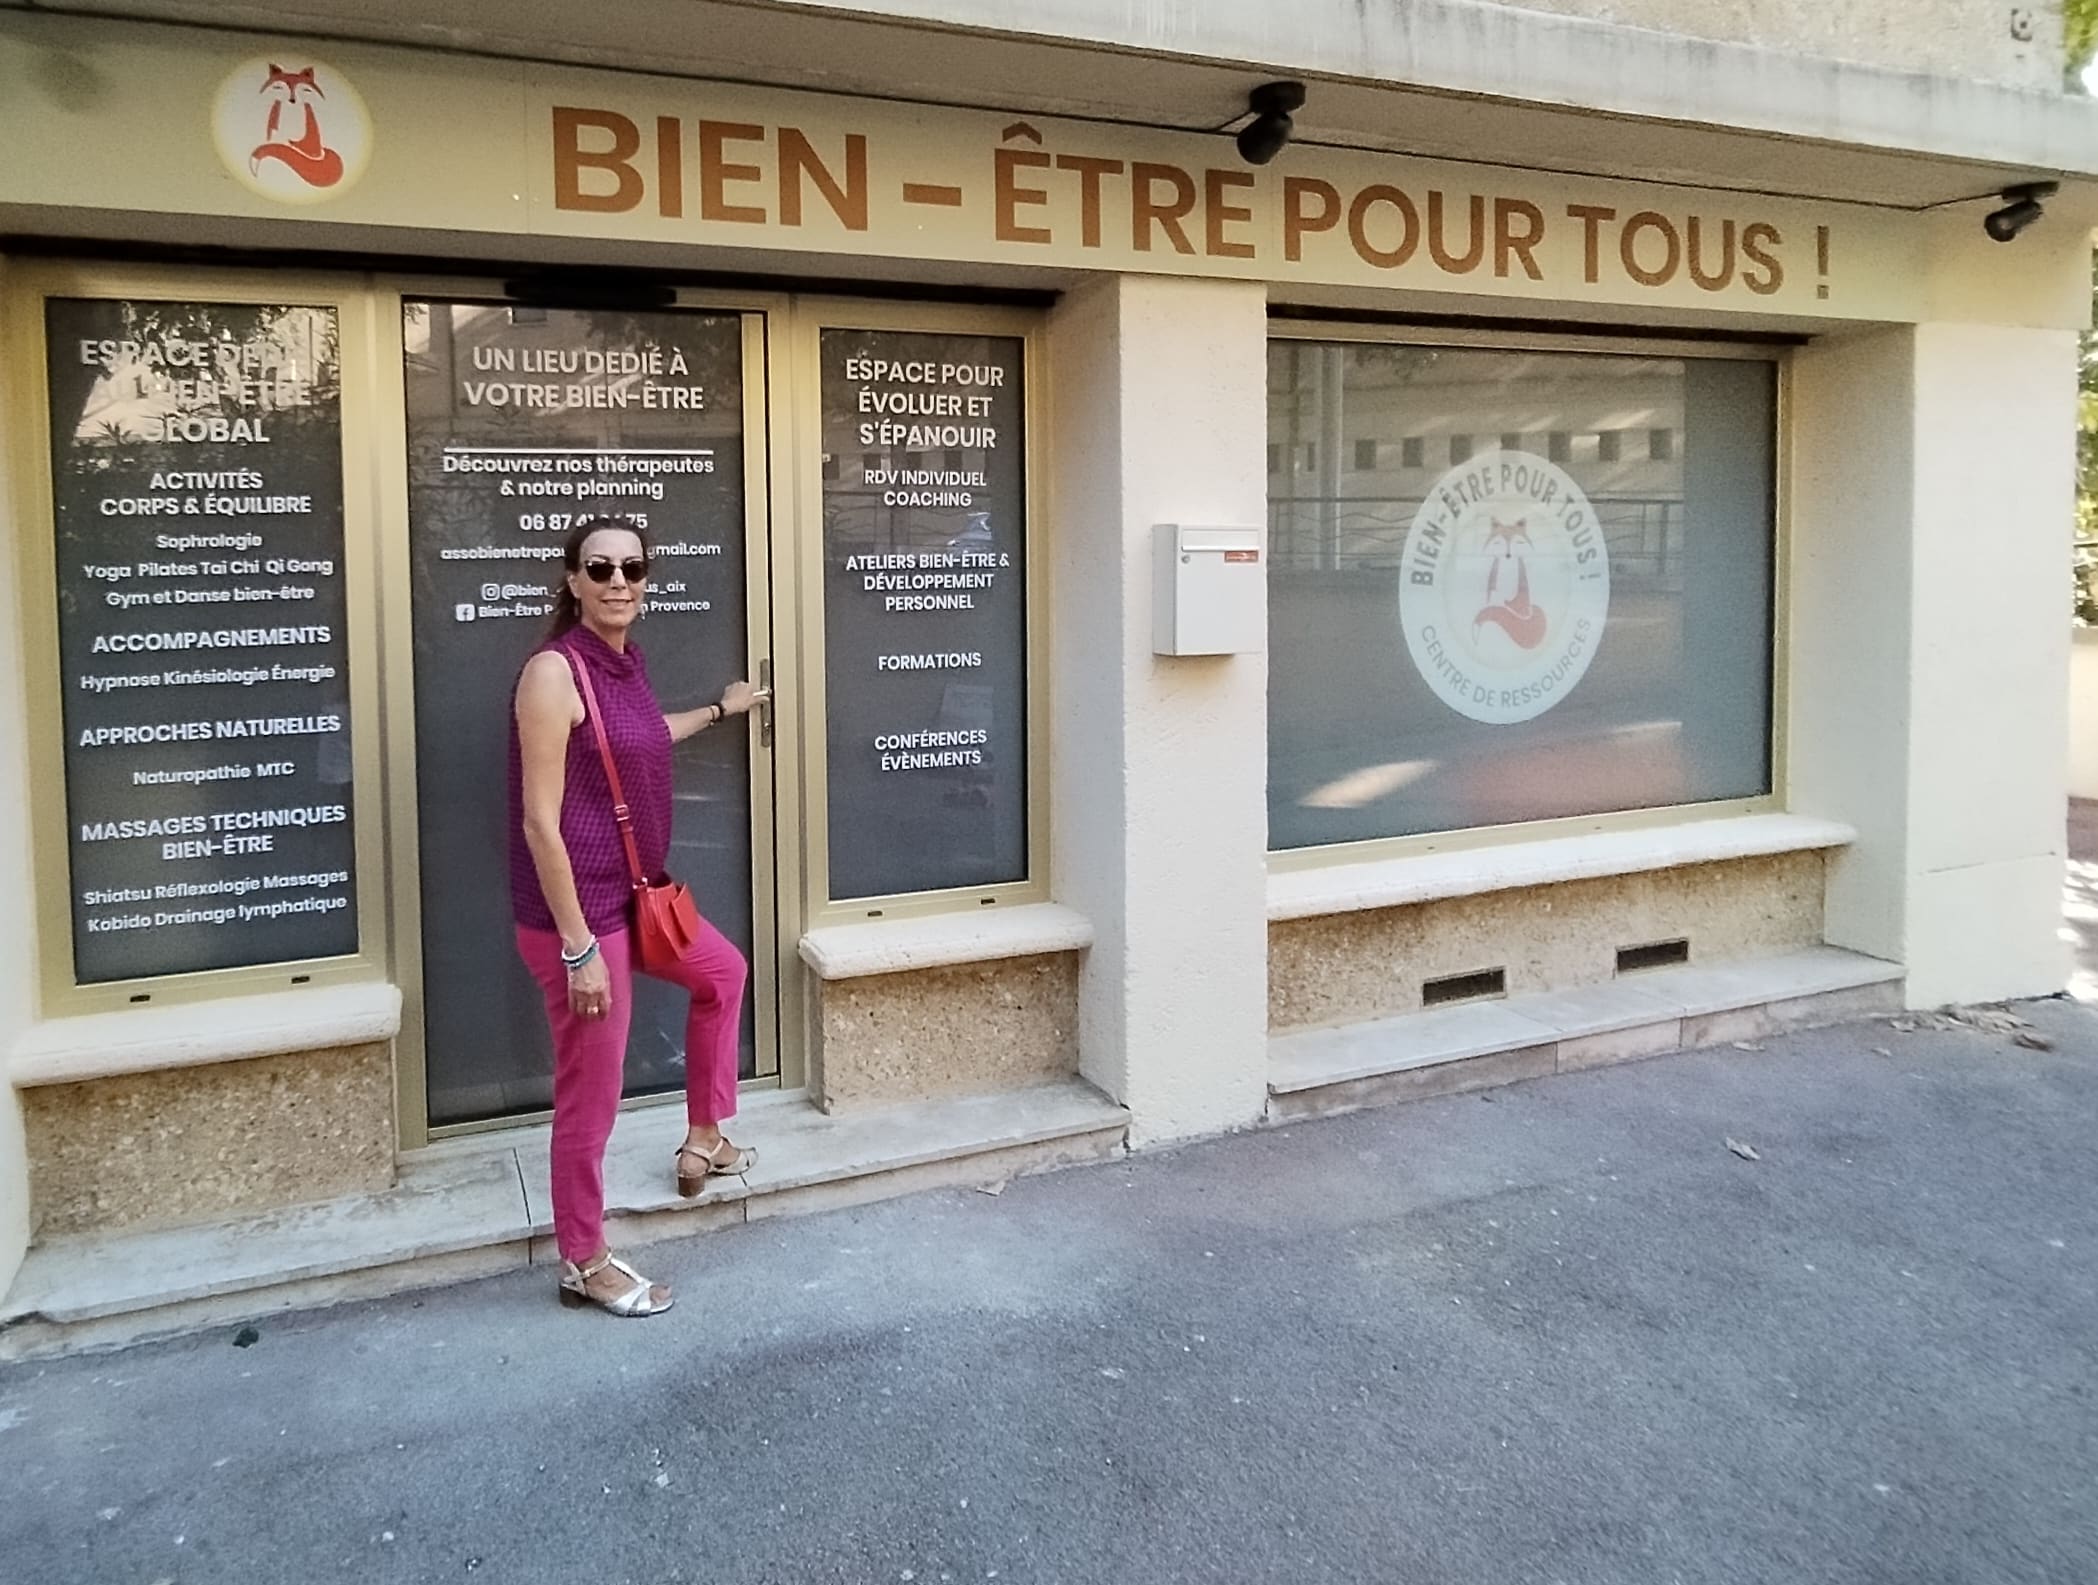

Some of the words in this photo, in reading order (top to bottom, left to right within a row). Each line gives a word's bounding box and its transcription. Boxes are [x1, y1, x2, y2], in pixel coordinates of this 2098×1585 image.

[553, 106, 868, 231] BIEN
[994, 121, 1256, 259] ÊTRE
[1284, 176, 1545, 281] POUR
[1567, 204, 1784, 295] TOUS
[80, 340, 209, 367] ESPACE
[473, 346, 515, 371] UN
[522, 349, 578, 373] LIEU
[669, 347, 689, 375] À
[846, 358, 936, 384] ESPACE
[942, 364, 1004, 386] POUR
[464, 381, 558, 407] VOTRE
[566, 380, 704, 409] BIEN-ÊTRE
[859, 386, 961, 416] ÉVOLUER
[967, 396, 993, 417] ET
[144, 418, 270, 443] GLOBAL
[860, 419, 996, 448] S'ÉPANOUIR
[443, 455, 552, 473] Découvrez
[556, 459, 593, 473] nos
[596, 455, 714, 477] thérapeutes
[864, 470, 898, 485] RDV
[902, 470, 987, 486] INDIVIDUEL
[150, 468, 263, 490] ACTIVITÉS
[500, 480, 515, 496] &
[519, 480, 573, 496] notre
[577, 479, 664, 500] planning
[100, 498, 180, 516] CORPS
[184, 498, 200, 515] &
[204, 494, 312, 516] ÉQUILIBRE
[884, 491, 972, 507] COACHING
[519, 514, 546, 530] 06
[549, 514, 572, 530] 87
[625, 513, 648, 529] 75
[1411, 466, 1496, 586] BIEN-ÊTRE
[1502, 463, 1559, 505] POUR
[1557, 494, 1597, 565] TOUS
[156, 533, 262, 551] Sophrologie
[83, 565, 131, 581] Yoga
[138, 561, 198, 576] Pilates
[200, 561, 227, 575] Tai
[231, 560, 259, 574] Chi
[266, 559, 285, 574] Qi
[846, 554, 916, 571] ATELIERS
[919, 550, 996, 568] BIEN-ÊTRE
[999, 553, 1009, 567] &
[864, 573, 994, 591] DÉVELOPPEMENT
[105, 592, 150, 609] Gym
[153, 590, 172, 604] et
[175, 589, 233, 604] Danse
[234, 586, 314, 602] bien-être
[650, 600, 710, 612] Provence
[885, 594, 974, 611] PERSONNEL
[92, 626, 331, 654] ACCOMPAGNEMENTS
[878, 652, 982, 670] FORMATIONS
[1422, 624, 1473, 697] CENTRE
[1473, 685, 1495, 708] DE
[1501, 618, 1591, 708] RESSOURCES
[81, 674, 160, 692] Hypnose
[163, 667, 268, 687] Kinésiologie
[272, 664, 335, 683] Énergie
[80, 723, 212, 747] APPROCHES
[216, 715, 341, 738] NATURELLES
[874, 729, 987, 751] CONFÉRENCES
[881, 750, 981, 771] ÉVÈNEMENTS
[133, 764, 251, 786] Naturopathie
[256, 762, 295, 778] MTC
[82, 816, 205, 841] MASSAGES
[210, 805, 346, 832] TECHNIQUES
[162, 835, 273, 860] BIEN-ÊTRE
[83, 887, 152, 905] Shiatsu
[155, 878, 260, 899] Réflexologie
[263, 870, 348, 890] Massages
[88, 914, 151, 932] Kobido
[155, 907, 236, 926] Drainage
[239, 896, 347, 920] lymphatique
